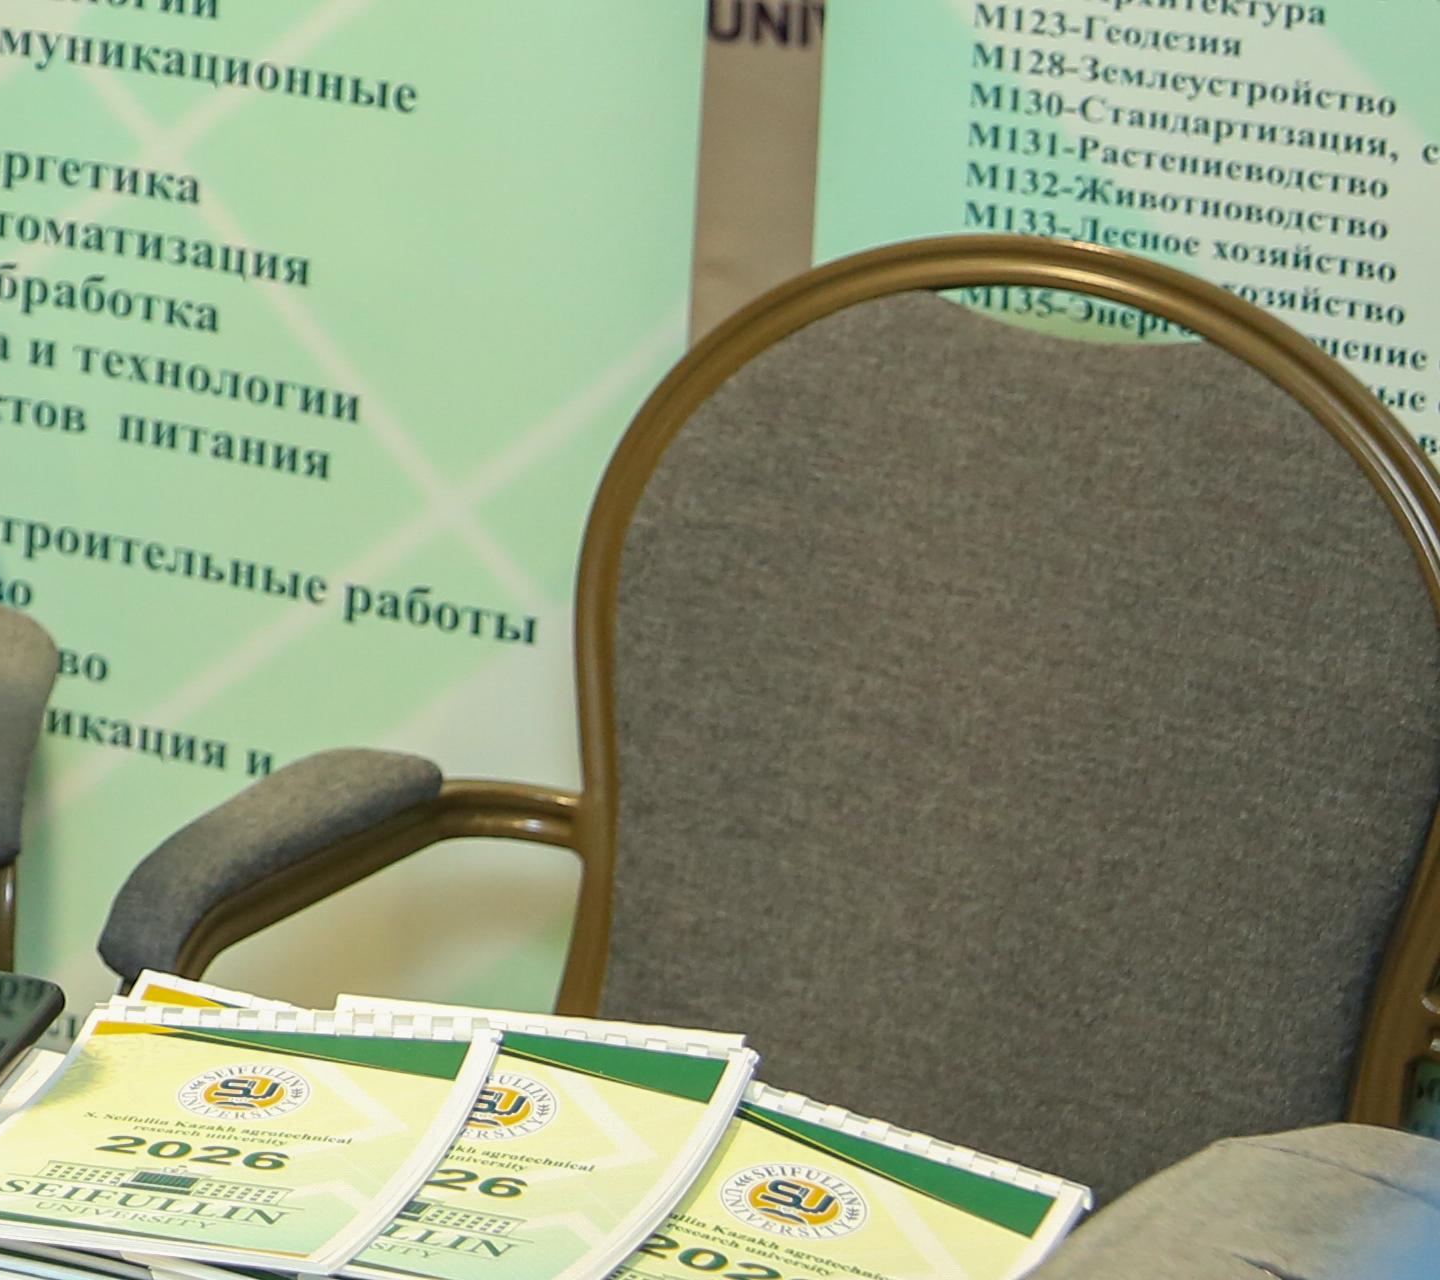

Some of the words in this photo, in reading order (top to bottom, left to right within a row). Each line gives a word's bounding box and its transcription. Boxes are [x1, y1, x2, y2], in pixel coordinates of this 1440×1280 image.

[1213, 240, 1397, 283] хозяйство
[72, 346, 360, 424] технологии
[118, 415, 330, 481] питания
[342, 581, 538, 644] работы
[94, 1134, 291, 1173] 2026
[35, 1201, 218, 1229] UNIVERSITY
